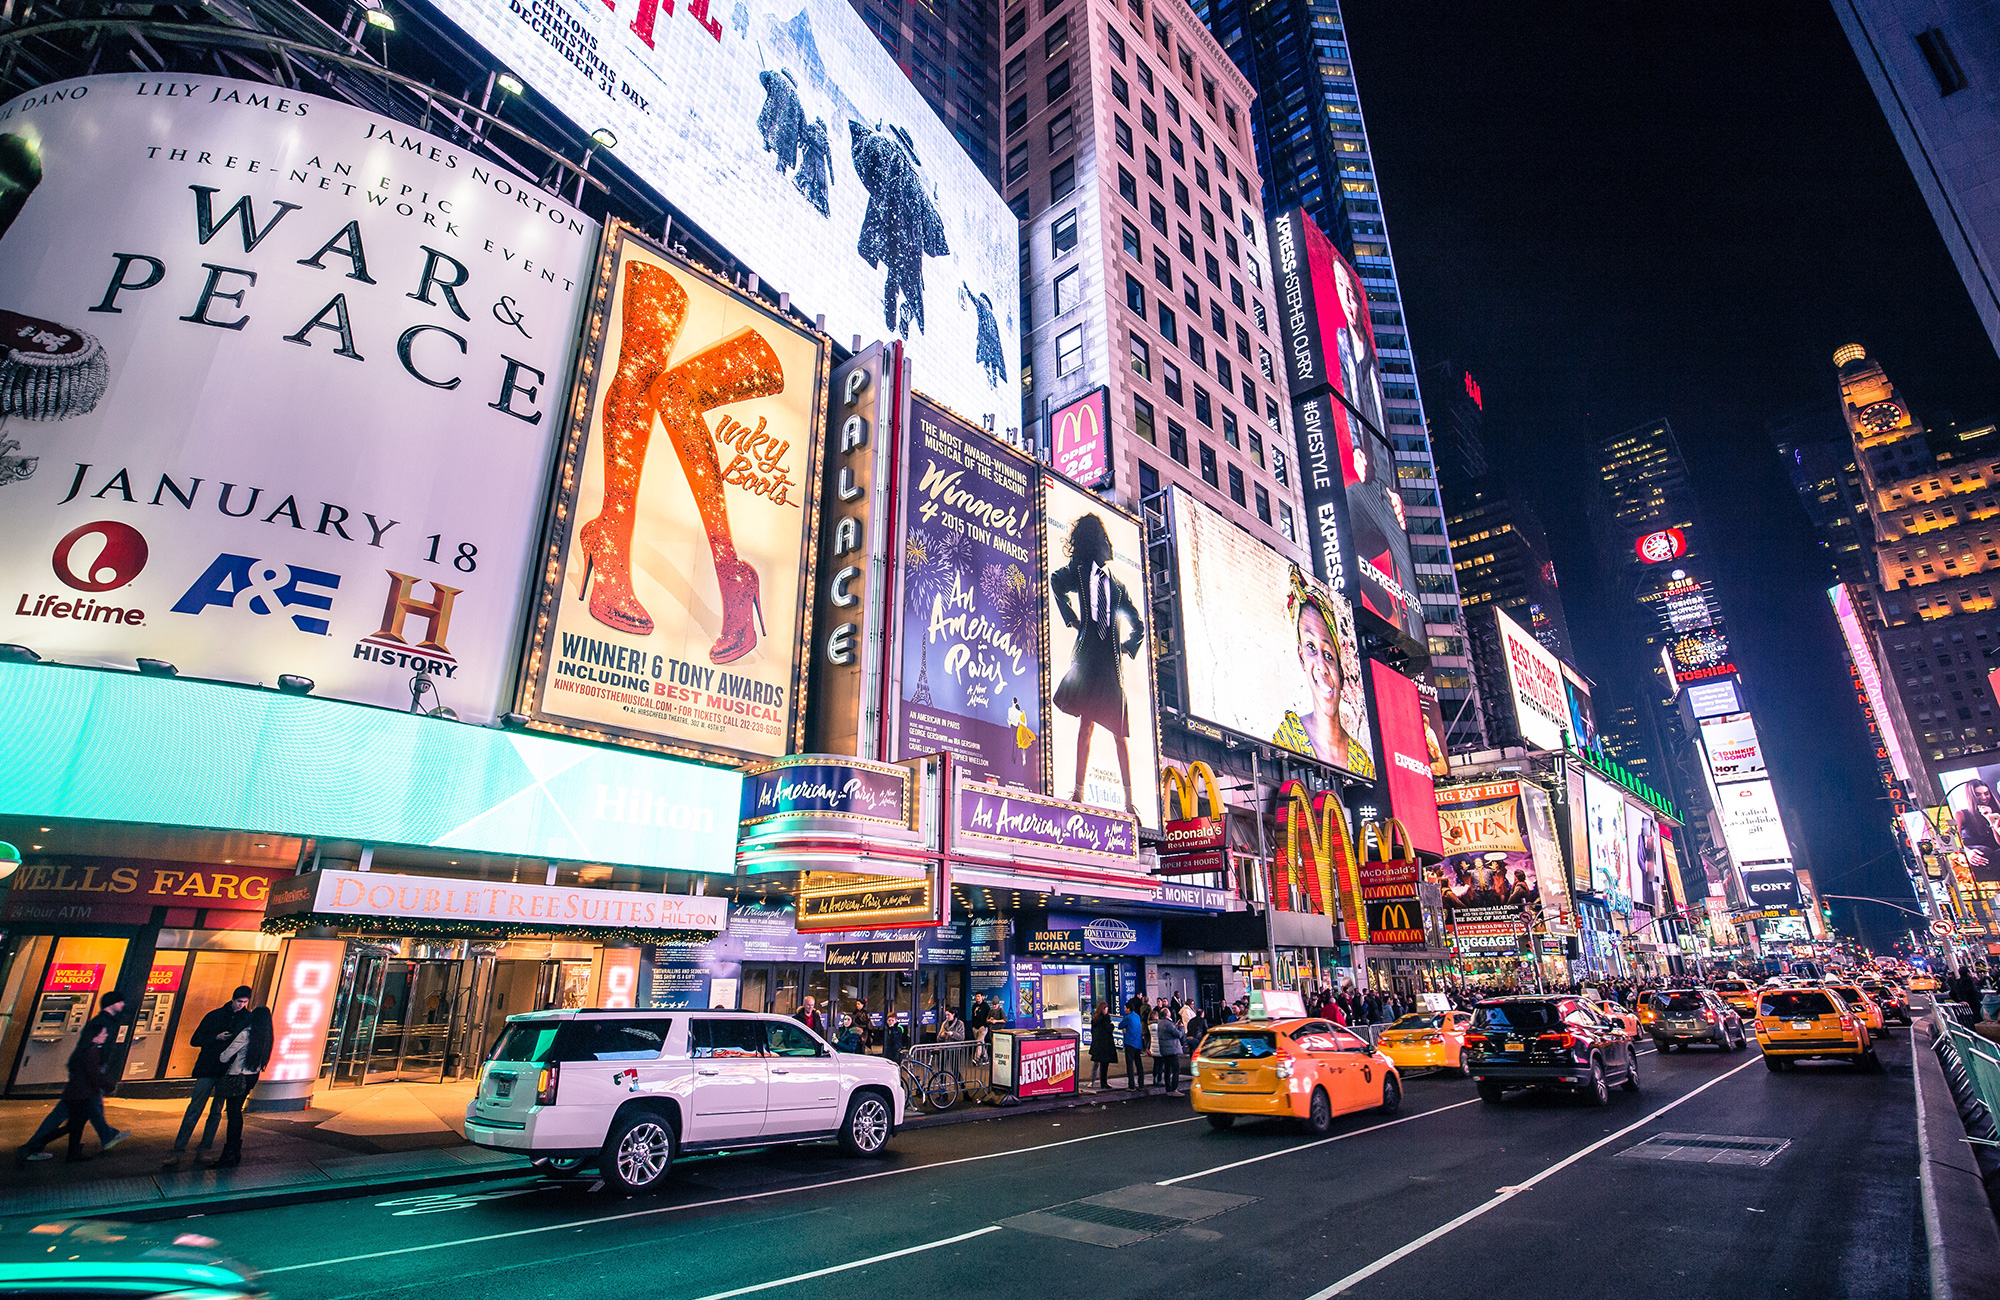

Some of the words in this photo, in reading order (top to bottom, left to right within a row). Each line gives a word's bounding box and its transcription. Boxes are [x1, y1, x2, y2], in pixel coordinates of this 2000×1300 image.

[509, 0, 594, 80] DECEMBER
[599, 78, 616, 101] 31.
[531, 0, 616, 83] CHRISTMAS
[620, 79, 650, 115] DAY.
[21, 86, 88, 112] DANO
[136, 82, 200, 97] LILY
[209, 87, 309, 118] JAMES
[306, 155, 353, 176] AN
[380, 176, 454, 214] EPIC
[364, 123, 458, 169] JAMES
[472, 166, 584, 237] NORTON
[147, 145, 459, 237] THREE-NETWORK
[483, 239, 575, 292] EVENT
[189, 184, 471, 322] WAR
[492, 296, 532, 339] &
[88, 253, 545, 425] PEACE
[1293, 335, 1314, 381] CURRY
[921, 419, 938, 434] THE
[939, 429, 962, 450] MOST
[964, 443, 1027, 486] AWARD-WINNING
[1060, 440, 1097, 464] OPEN
[1303, 401, 1332, 490] #GIVESTYLE
[721, 455, 799, 508] Boots
[924, 435, 964, 466] MUSICAL
[965, 455, 976, 470] OF
[977, 462, 992, 480] THE
[993, 471, 1025, 498] SEASON!
[1065, 455, 1093, 477] 24
[828, 367, 870, 666] PALACE
[919, 459, 1029, 539] Winner!
[57, 463, 401, 549] JANUARY
[423, 534, 478, 572] 18
[919, 501, 938, 523] 4
[941, 511, 964, 534] 2015
[966, 522, 991, 545] TONY
[993, 535, 1029, 564] AWARDS
[1317, 501, 1345, 591] EXPRESS
[15, 594, 145, 627] Lifetime
[170, 553, 342, 637] A&E
[948, 569, 976, 613] An
[1663, 583, 1701, 597] TOSHIBA
[1667, 595, 1704, 610] TOSHIBA
[927, 591, 1026, 676] American
[353, 643, 457, 679] HISTORY
[562, 632, 647, 676] WINNER!
[651, 655, 662, 679] 6
[669, 658, 715, 691] TONY
[717, 672, 784, 708] AWARDS
[943, 644, 1008, 695] Paris
[1508, 634, 1532, 674] BEST
[1689, 653, 1717, 664] 2016
[1676, 663, 1737, 682] TOSHIBA
[554, 678, 672, 713] KINKYBOOTSTHEMUSICAL.COM
[678, 704, 692, 717] FOR
[693, 709, 722, 724] TICKETS
[723, 715, 739, 728] CALL
[740, 718, 782, 737] 212-239-6200
[557, 660, 650, 693] INCLUDING
[654, 682, 702, 705] BEST
[706, 694, 782, 723] MUSICAL
[1850, 665, 1876, 733] ERNST
[1724, 752, 1756, 761] DONUTS
[592, 784, 714, 833] Hilton
[758, 782, 772, 809] An
[772, 776, 839, 807] American
[843, 778, 876, 810] Paris
[1088, 784, 1121, 804] Matilda
[1458, 788, 1482, 801] FAT
[970, 797, 993, 829] An
[995, 798, 1064, 845] American
[1066, 814, 1101, 850] Paris
[1167, 826, 1222, 841] cDonald's
[1167, 838, 1211, 849] Restaurant
[1162, 861, 1180, 869] OPEN
[1194, 858, 1219, 866] HOURS
[1360, 865, 1416, 878] McDonald's
[1370, 875, 1407, 883] Restaurant
[12, 865, 140, 893] WELLS
[148, 869, 270, 901] FARG
[1166, 888, 1200, 903] MONEY
[1206, 893, 1224, 906] ATM
[1751, 883, 1791, 892] SONY
[25, 907, 52, 918] Hour
[57, 905, 92, 918] ATM
[661, 912, 717, 926] HILTON
[663, 900, 684, 911] BY
[744, 906, 787, 920] Triumph!
[828, 897, 861, 913] American
[863, 893, 882, 909] Paris
[850, 930, 870, 938] 2015
[872, 930, 893, 941] Tony
[893, 928, 926, 941] Awards!
[1028, 941, 1081, 951] EXCHANGE
[1035, 931, 1070, 941] MONEY
[1105, 930, 1137, 940] EXCHANGE
[1452, 936, 1515, 948] LUGGAGE
[827, 949, 859, 970] Winner!
[860, 951, 869, 966] 4
[871, 952, 888, 964] TONY
[888, 951, 915, 964] AWARDS
[54, 976, 91, 984] FARGO
[1020, 1055, 1053, 1085] JERSEY
[1055, 1049, 1076, 1075] BOYS
